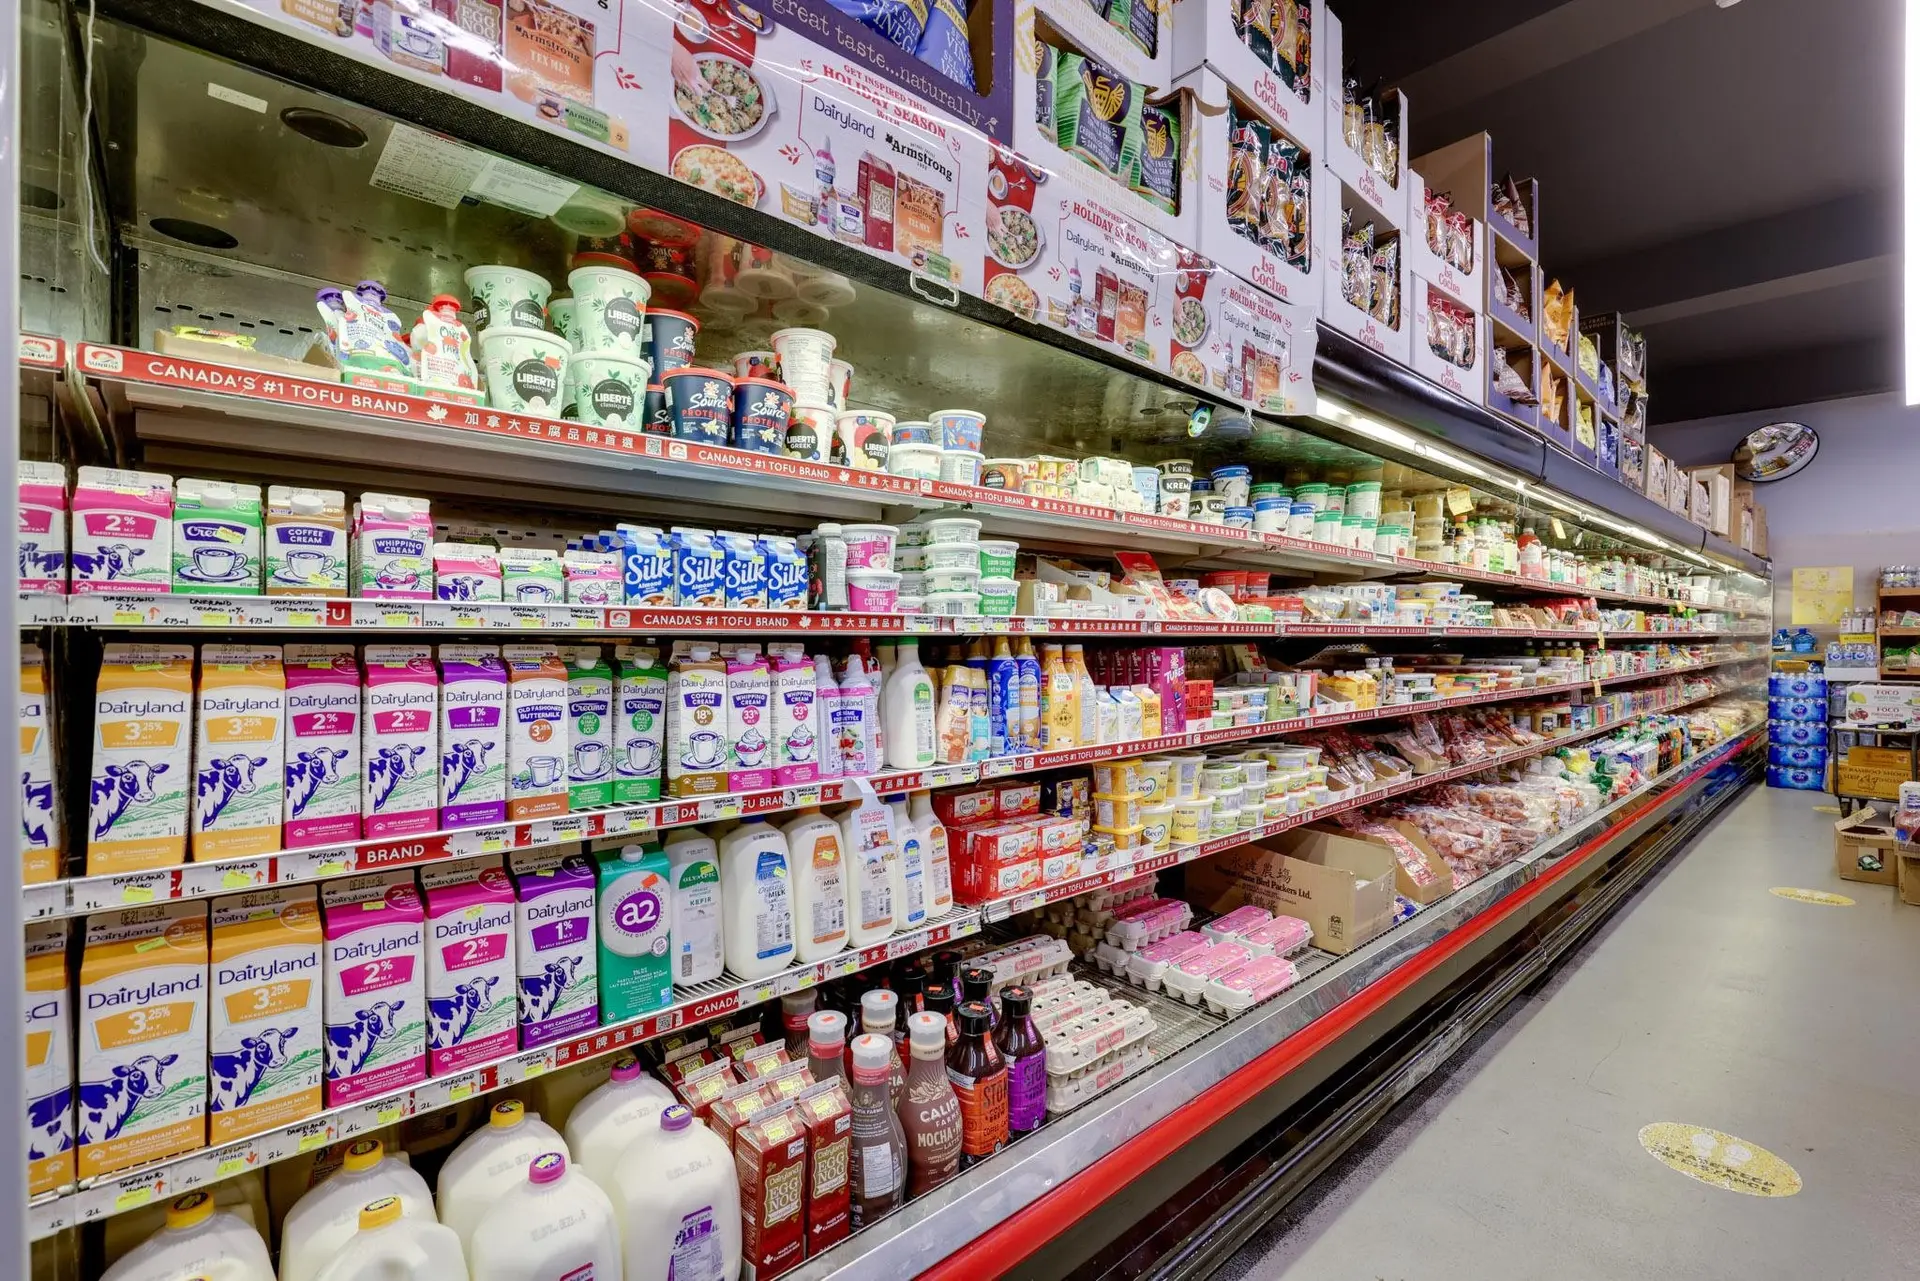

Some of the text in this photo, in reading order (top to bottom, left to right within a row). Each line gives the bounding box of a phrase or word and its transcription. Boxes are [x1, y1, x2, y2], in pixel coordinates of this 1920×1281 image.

[461, 6, 496, 28] EGG
[772, 0, 829, 36] great
[900, 10, 921, 40] SALT
[461, 18, 495, 37] NOG
[520, 31, 581, 64] Armstrong
[530, 51, 570, 77] TEX MEX
[844, 64, 928, 113] GET INSPIRED THIS
[823, 64, 946, 139] HOLIDAY SEASON
[1254, 82, 1290, 124] Cocina
[814, 96, 875, 139] Dairyland
[877, 110, 900, 127] WITH
[892, 138, 953, 184] Armstrong
[1359, 178, 1384, 208] Cocina
[1086, 199, 1098, 210] GET
[1073, 203, 1112, 233] HOLIDAY
[1066, 228, 1104, 258] Dairyland
[1115, 254, 1154, 283] Armstrong
[1252, 267, 1288, 297] Cocina
[1230, 287, 1282, 325] HOLIDAY SEASON
[608, 309, 642, 327] LIBERTÉ
[1224, 310, 1250, 333] Dairyland
[1359, 327, 1385, 353] Cocina
[148, 361, 409, 415] CANADA'S #1 TOFU BRAND
[516, 372, 558, 390] LIBERTÉ
[522, 382, 551, 395] classique
[595, 392, 635, 407] LIBERTÉ
[600, 401, 630, 412] classique
[690, 394, 728, 409] Source
[750, 402, 786, 418] Source
[786, 434, 818, 445] LIBERTÉ
[791, 442, 813, 450] GREEK
[698, 450, 830, 479] CANADA'S #1 TOFU BRAND
[938, 484, 1025, 507] CANADA'S #1 TOFU BRAND
[105, 514, 136, 532] 2%
[288, 528, 324, 538] COFFEE
[289, 535, 322, 544] CREAM
[376, 538, 423, 550] WHIPPING
[384, 545, 416, 556] CREAM
[625, 553, 673, 586] Silk
[680, 556, 725, 588] Silk
[725, 558, 767, 590] Silk
[769, 560, 808, 591] Silk
[112, 586, 145, 594] CANADIAN
[638, 580, 662, 590] Almond
[691, 581, 715, 591] Almond
[866, 582, 891, 591] Dairyland
[865, 597, 890, 607] COTTAGE
[643, 615, 789, 627] CANADA'S #1 TOFU BRAND
[780, 678, 816, 690] Dairyland
[1165, 668, 1186, 684] TUBES
[514, 687, 566, 700] Dairyland
[623, 685, 665, 699] Dairyland
[730, 679, 769, 692] Dairyland
[289, 694, 357, 709] Dairyland
[371, 691, 434, 707] Dairyland
[446, 691, 503, 704] Dairyland
[691, 692, 715, 701] COFFEE
[692, 698, 715, 706] CREAM
[735, 693, 766, 702] WHIPPING
[786, 690, 813, 699] WHIPPING
[98, 701, 186, 717] Dairyland
[202, 698, 281, 714] Dairyland
[529, 704, 562, 714] FASHIONED
[572, 703, 606, 712] Creamo
[627, 701, 660, 710] Creamo
[743, 709, 759, 719] 33%
[313, 712, 338, 731] 2%
[391, 711, 415, 728] 2%
[468, 707, 486, 723] 1%
[520, 711, 560, 720] BUTTERMILK
[695, 709, 711, 721] 18%
[1039, 746, 1112, 766] CANADA'S TOFU BRAND
[859, 810, 885, 819] HOLIDAY
[860, 816, 885, 825] SEASON
[1146, 828, 1163, 837] Becel
[1176, 821, 1196, 830] Original
[366, 844, 425, 864] BRAND
[683, 872, 716, 883] OLYMPIC
[871, 866, 886, 875] MILK
[823, 878, 840, 887] MILK
[1256, 876, 1270, 888] Bird
[1271, 880, 1298, 896] Packers
[1298, 888, 1312, 900] Ltd.
[325, 892, 382, 906] Dairyland
[690, 896, 712, 907] KEFIR
[769, 888, 786, 899] MILK
[527, 896, 594, 921] Dairyland
[621, 899, 657, 926] a2
[88, 925, 162, 943] Dairyland
[436, 911, 513, 940] Dairyland
[555, 920, 573, 940] 1%
[334, 931, 421, 962] Dairyland
[462, 937, 490, 961] 2%
[218, 951, 319, 986] Dairyland
[363, 959, 394, 986] 2%
[88, 973, 203, 1011] Dairyland
[352, 1061, 416, 1086] 100% CANADIAN MILK
[109, 1124, 192, 1150] 100% CANADIAN MILK
[818, 1152, 845, 1172] EGG
[817, 1163, 845, 1183] NOG
[770, 1175, 799, 1201] EGG
[769, 1189, 799, 1212] NOG
